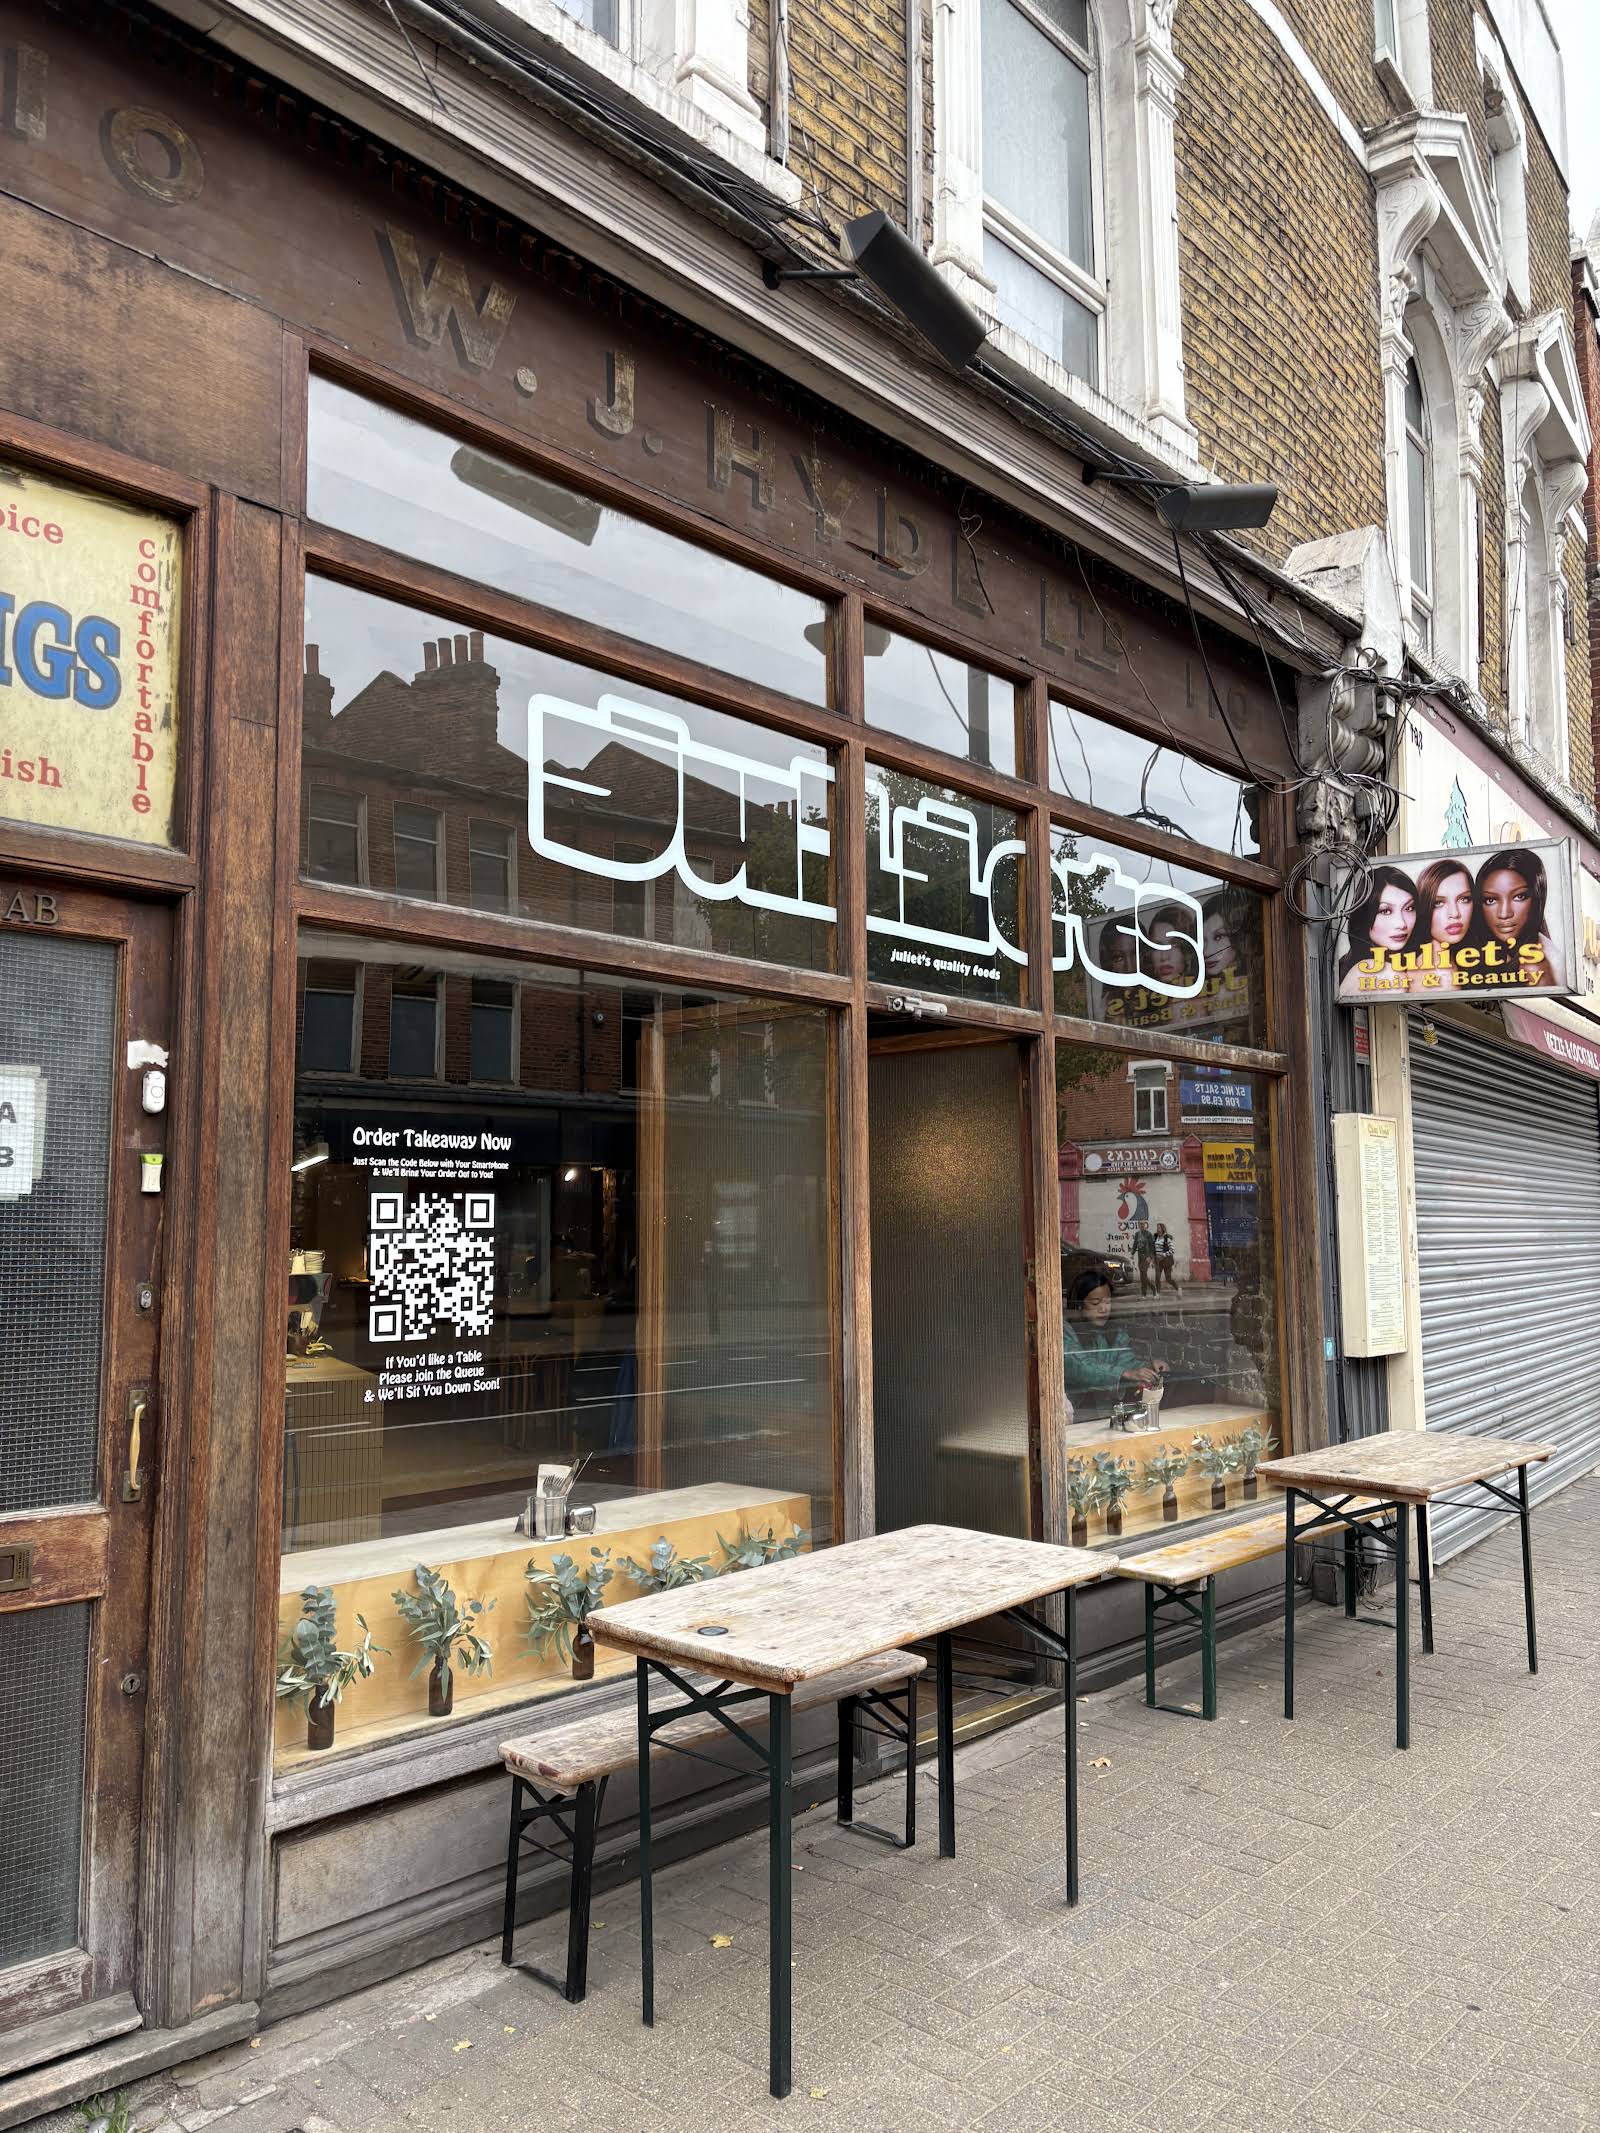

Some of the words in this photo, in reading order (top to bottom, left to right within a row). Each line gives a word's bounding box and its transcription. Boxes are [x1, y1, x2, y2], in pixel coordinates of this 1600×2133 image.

[377, 221, 539, 396] W.
[586, 350, 663, 455] J.
[705, 401, 988, 617] HYDE
[130, 538, 160, 814] comfortable
[3, 891, 60, 925] AB
[890, 948, 931, 967] juliet's
[933, 957, 971, 978] quality
[973, 964, 1002, 982] foods
[1358, 937, 1545, 974] Juliet's
[1358, 976, 1414, 992] Hair
[1422, 973, 1441, 988] &
[1453, 968, 1545, 988] Beauty
[353, 1126, 400, 1146] Order
[403, 1129, 477, 1149] Takeaway
[481, 1133, 512, 1150] Now
[353, 1157, 368, 1166] Just
[369, 1157, 387, 1166] Scan
[388, 1158, 399, 1167] the
[400, 1158, 418, 1167] Code
[419, 1159, 439, 1168] Below
[440, 1158, 454, 1168] with
[455, 1160, 471, 1169] Your
[472, 1160, 509, 1170] Smartphone
[373, 1168, 380, 1176] &
[382, 1168, 399, 1177] We'll
[400, 1168, 419, 1177] Bring
[420, 1169, 437, 1177] Your
[438, 1169, 457, 1178] Order
[458, 1169, 470, 1178] Out
[471, 1170, 478, 1178] to
[479, 1170, 494, 1179] You!
[386, 1356, 394, 1369] If
[395, 1353, 426, 1368] You'd
[428, 1353, 445, 1366] like
[448, 1354, 454, 1364] a
[456, 1350, 482, 1364] Table
[379, 1372, 413, 1385] Please
[414, 1370, 434, 1383] join
[436, 1367, 452, 1380] the
[454, 1366, 484, 1379] Queue
[364, 1389, 376, 1403] &
[378, 1387, 404, 1401] We'll
[405, 1385, 421, 1399] Sit
[423, 1384, 442, 1397] You
[444, 1380, 471, 1394] Down
[473, 1377, 501, 1391] Soon!
